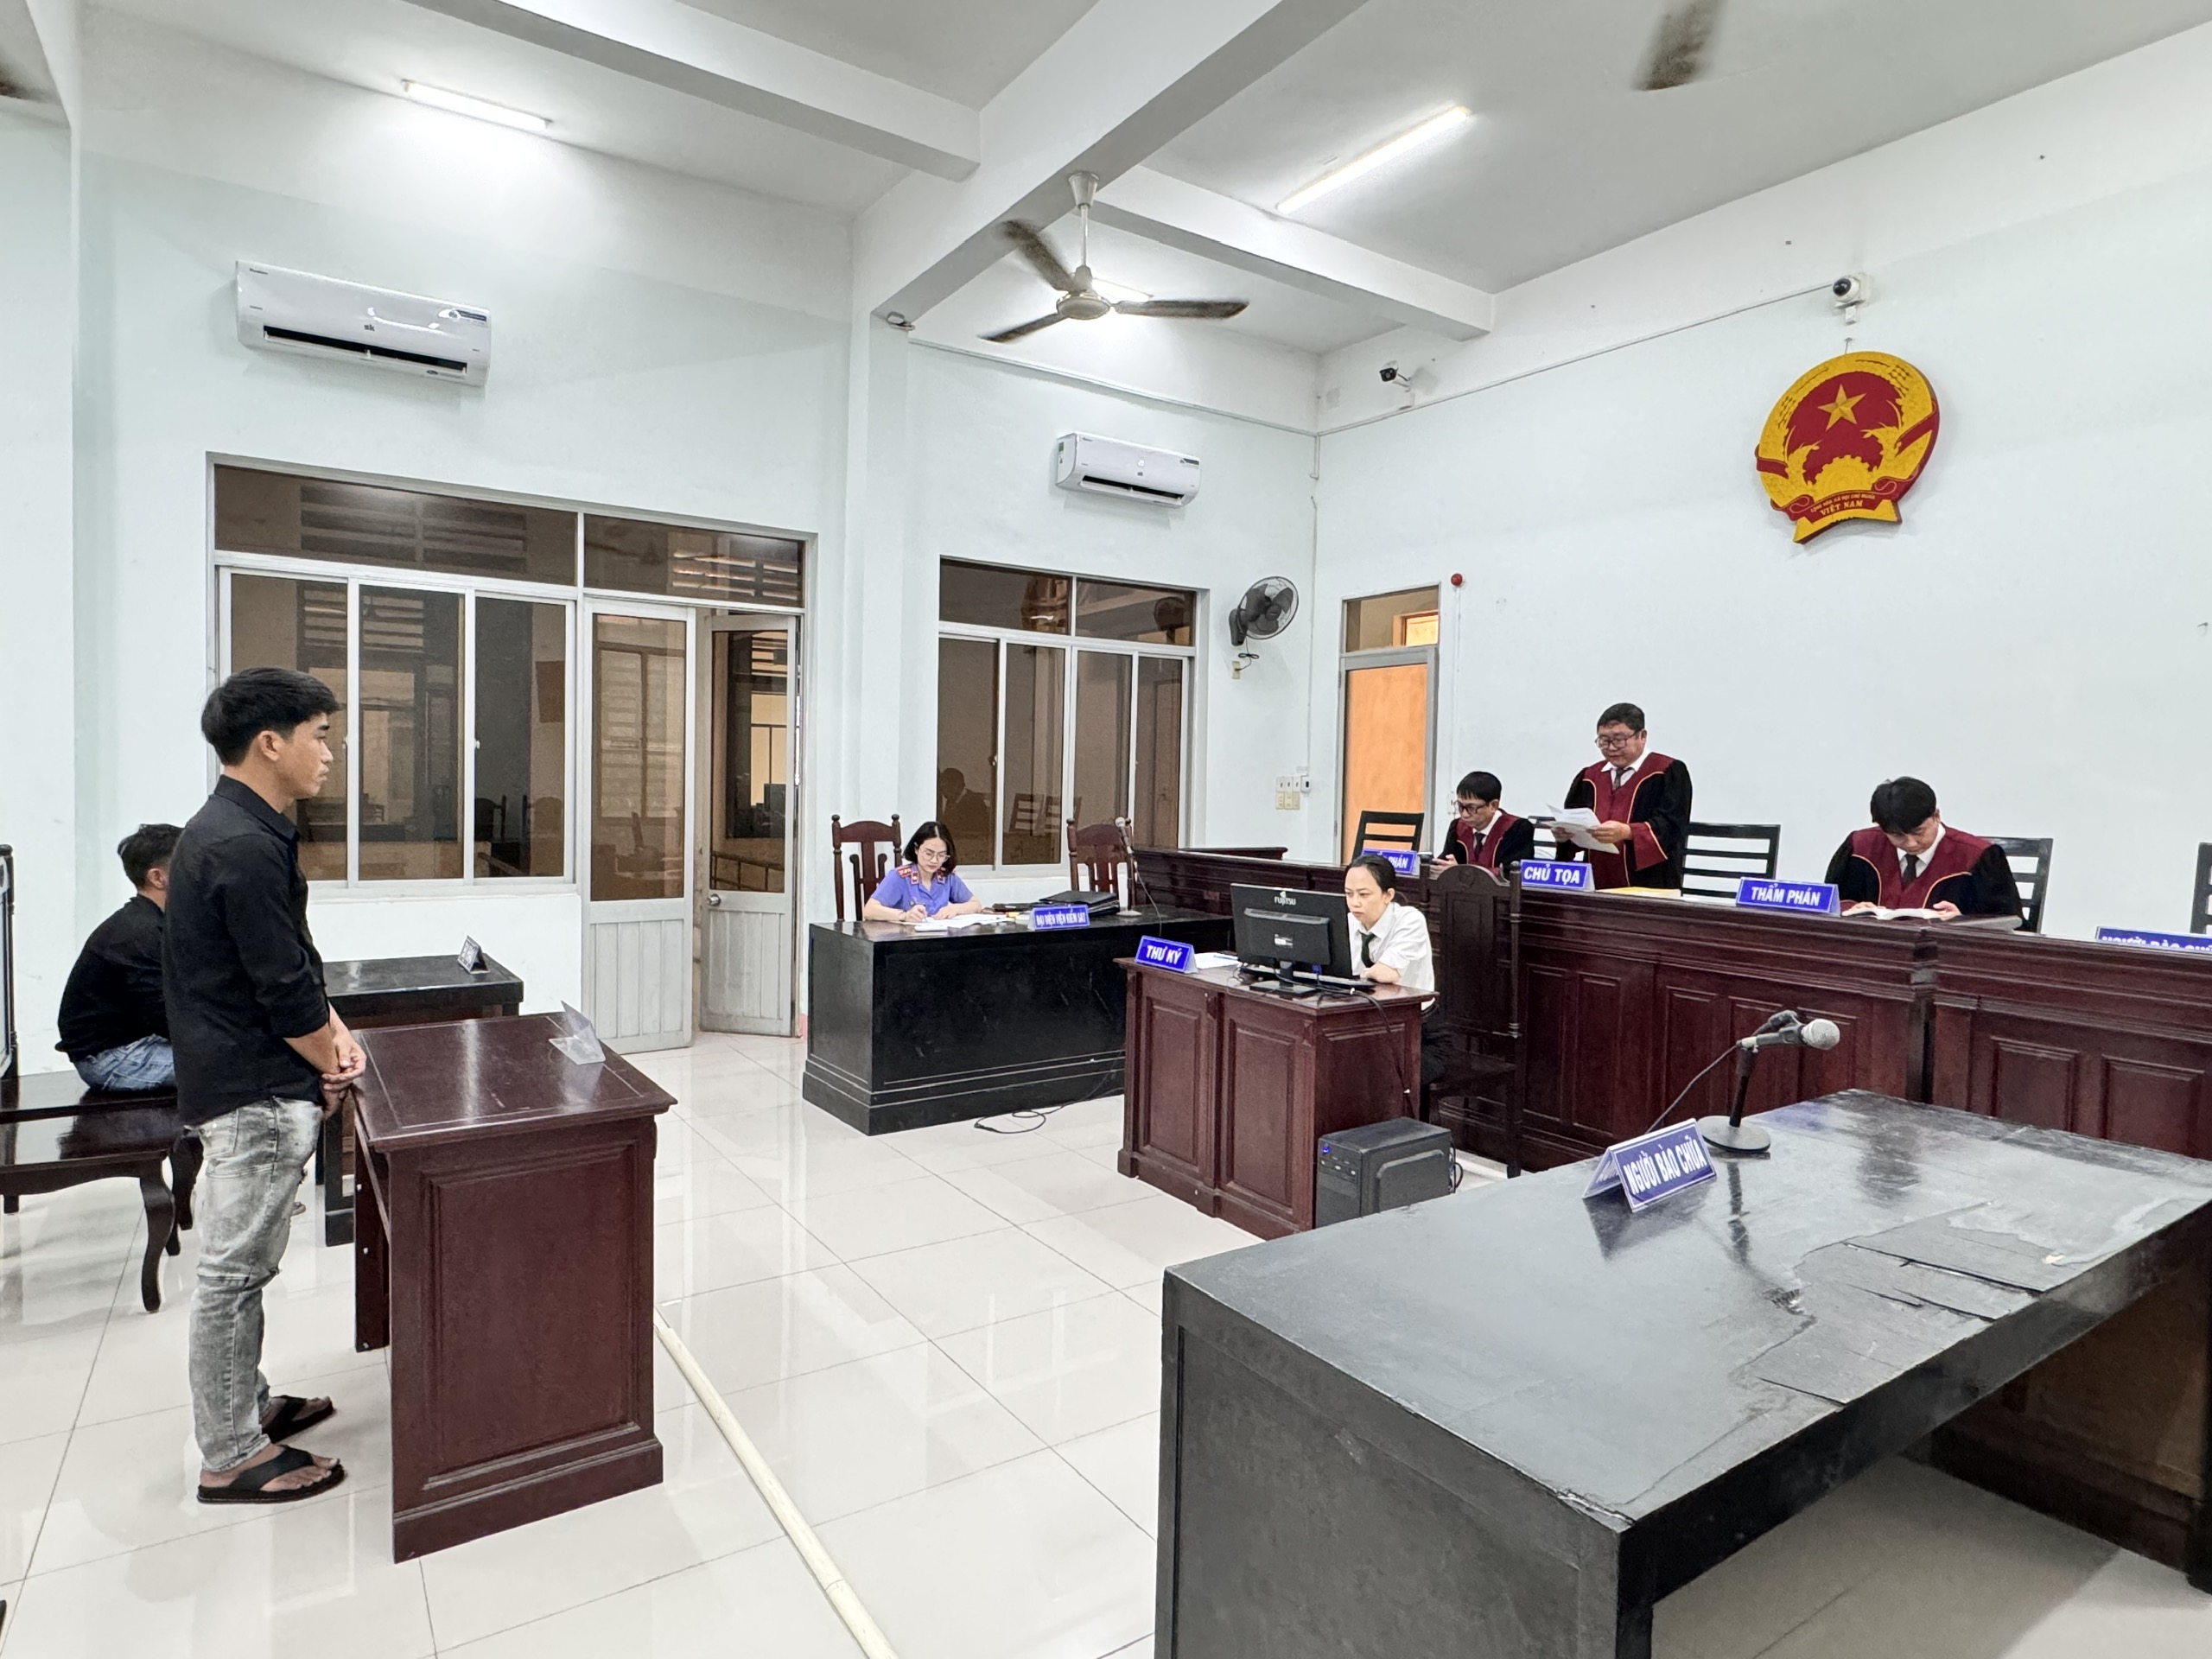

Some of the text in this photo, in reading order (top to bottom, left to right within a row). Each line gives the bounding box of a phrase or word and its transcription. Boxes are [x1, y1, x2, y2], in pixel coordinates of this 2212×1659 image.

[1843, 499, 1863, 509] NAM
[1523, 863, 1580, 885] CHỦ TỌA
[1274, 896, 1297, 906] FUJITSU
[1751, 883, 1821, 906] THẨM PHÁN
[1146, 944, 1182, 965] THƯ KÝ
[1623, 1150, 1662, 1195] NGƯỜI
[1654, 1143, 1681, 1182] BÀO
[1675, 1135, 1707, 1174] CHỮA
